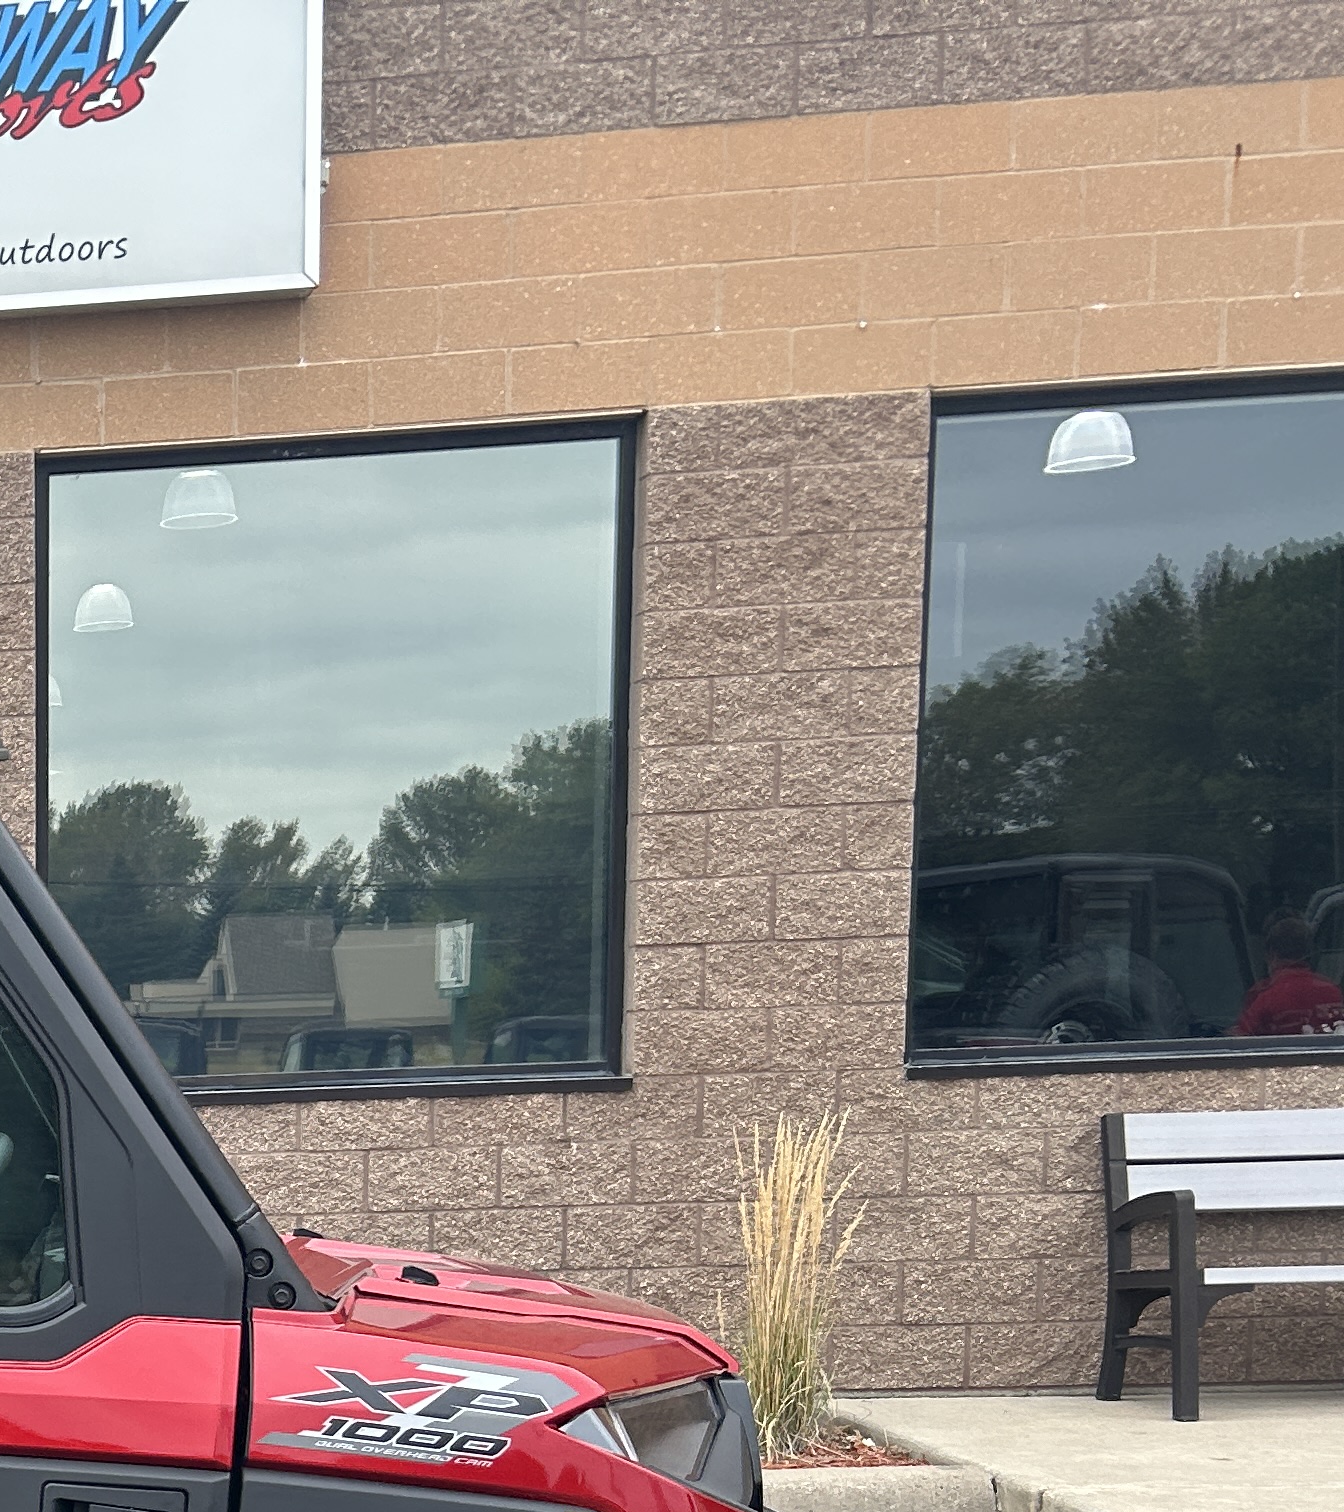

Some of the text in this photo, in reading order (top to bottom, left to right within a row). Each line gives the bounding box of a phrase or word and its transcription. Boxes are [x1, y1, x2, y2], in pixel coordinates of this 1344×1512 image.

[268, 1365, 554, 1421] XP
[314, 1440, 495, 1468] DUAL OVERHEAD CAM
[319, 1417, 512, 1459] 1000
